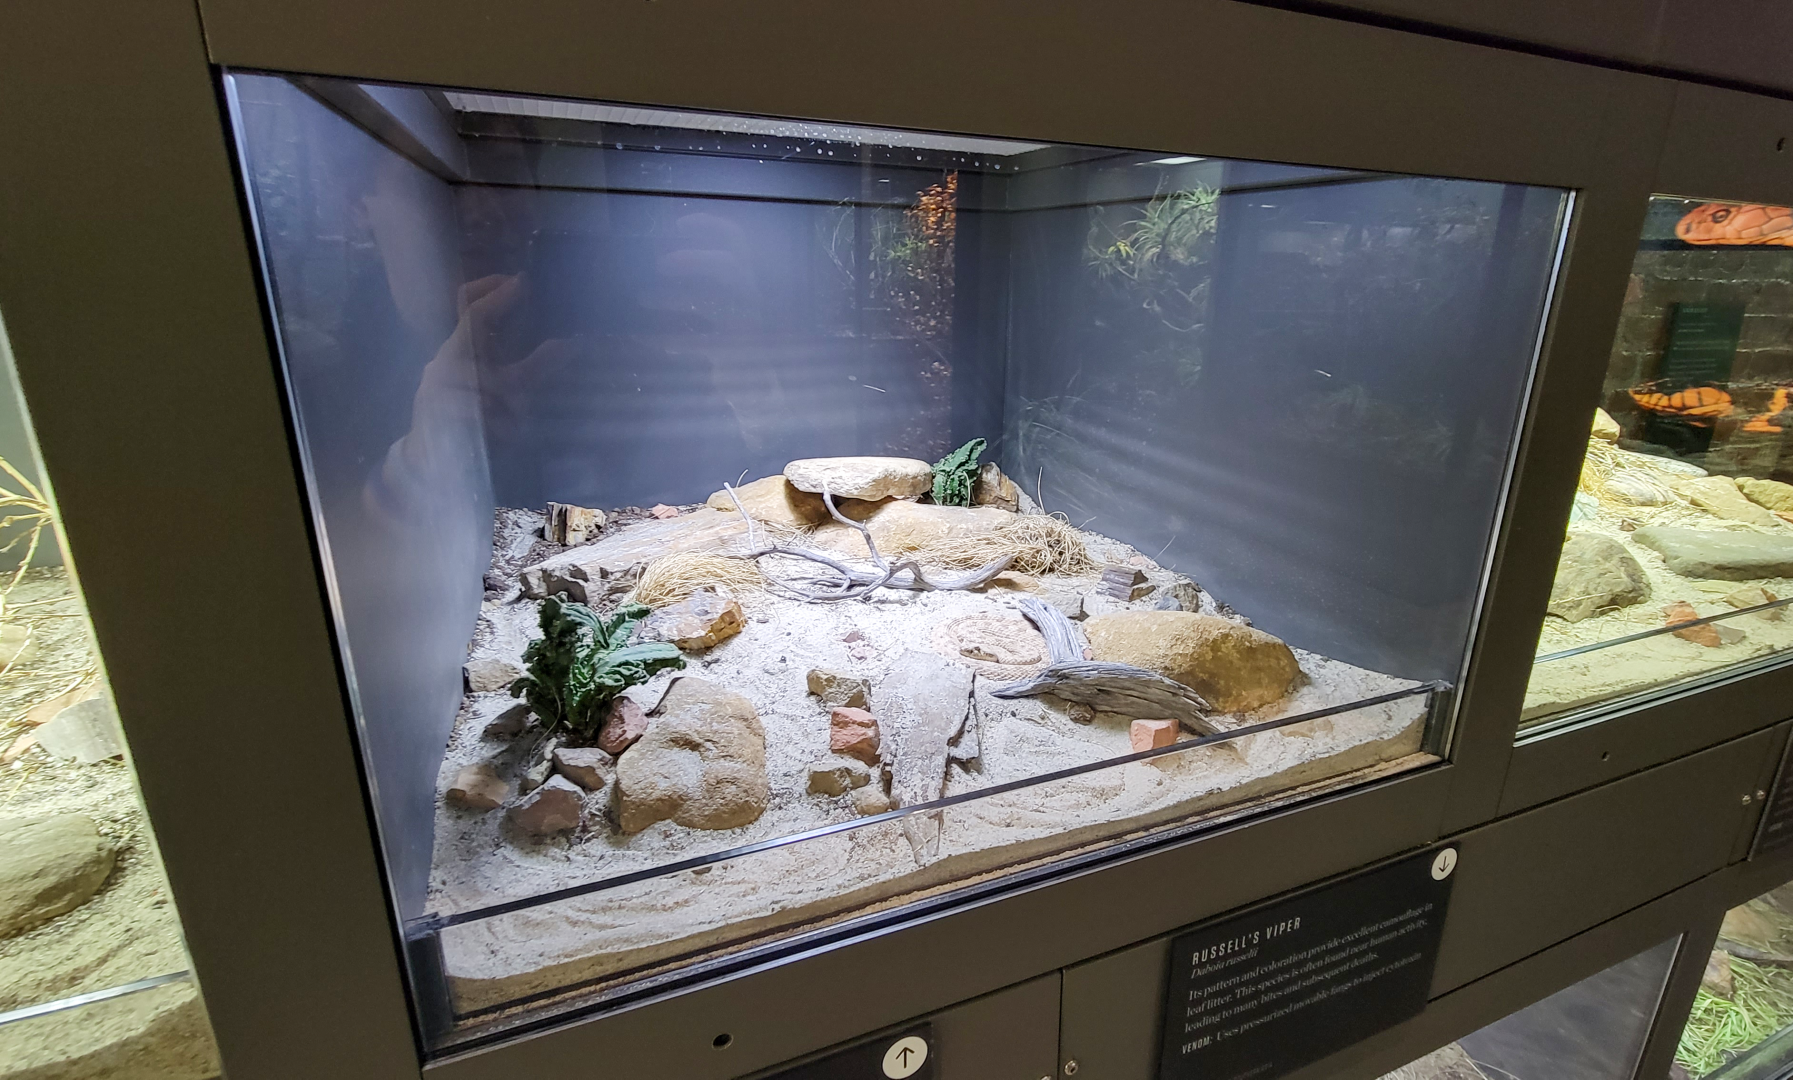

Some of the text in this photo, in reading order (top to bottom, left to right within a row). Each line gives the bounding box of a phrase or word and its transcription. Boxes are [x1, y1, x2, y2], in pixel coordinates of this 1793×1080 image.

[1189, 989, 1203, 1001] Its
[1204, 976, 1240, 998] pattern
[1241, 966, 1259, 982] and
[1260, 952, 1307, 975] coloration
[1307, 937, 1341, 959] provide
[1190, 960, 1225, 979] Daboia
[1192, 917, 1301, 966] RUSSELL'S VIPER
[1185, 1012, 1220, 1033] leading
[1222, 1009, 1232, 1019] to
[1233, 999, 1258, 1014] many
[1260, 990, 1283, 1004] bites
[1283, 980, 1301, 995] and
[1186, 1000, 1206, 1018] leaf
[1235, 984, 1255, 999] This
[1257, 973, 1290, 991] species
[1291, 968, 1299, 977] is
[1299, 958, 1323, 975] often
[1324, 946, 1349, 965] found
[1182, 1036, 1213, 1055] VENOM:
[1217, 1027, 1239, 1041] Uses
[1240, 1003, 1293, 1034] pressurized
[1353, 977, 1362, 986] to
